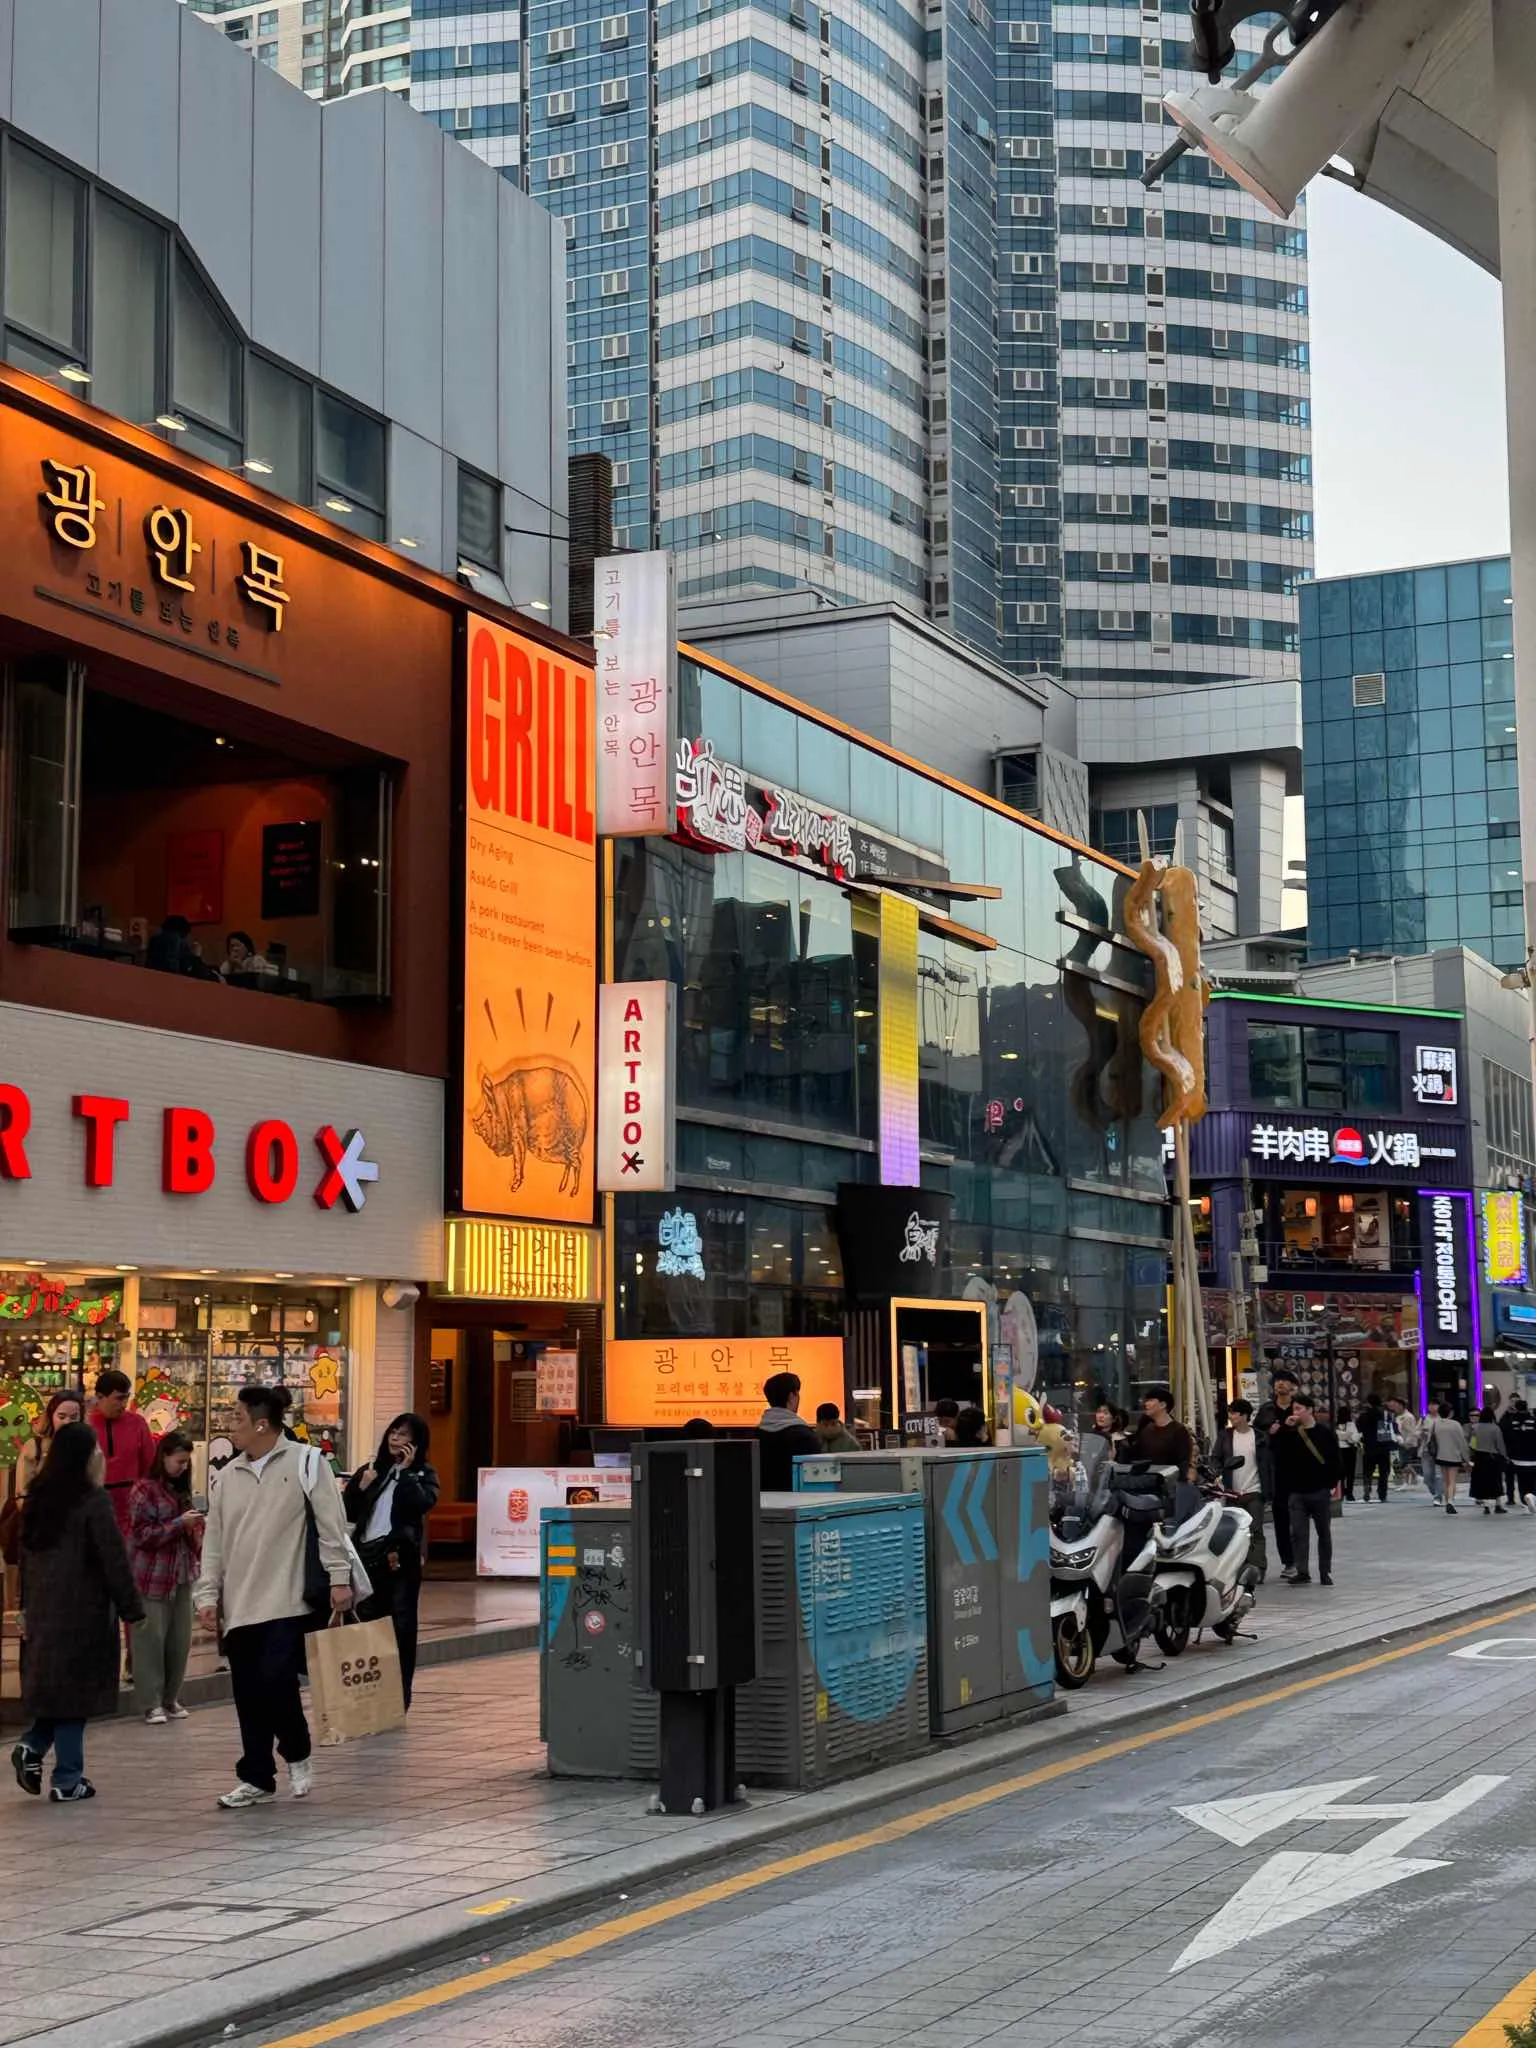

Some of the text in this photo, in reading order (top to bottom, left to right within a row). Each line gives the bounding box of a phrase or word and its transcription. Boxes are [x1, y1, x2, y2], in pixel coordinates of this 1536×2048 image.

[40, 458, 290, 632] 광안목
[603, 569, 621, 758] 고기를 보는 안목
[470, 627, 594, 846] GRILL
[629, 677, 662, 822] 광안목
[470, 836, 514, 866] Dry Aging
[470, 869, 518, 897] Asado Grill
[469, 899, 545, 934] A pork restaurant
[497, 932, 521, 948] never
[522, 935, 542, 953] been
[620, 998, 645, 1175] ARTBOX
[1411, 1073, 1444, 1095] 火鍋
[1250, 1123, 1421, 1168] 羊肉串 火鍋
[653, 1346, 793, 1374] 광안목
[655, 1381, 710, 1397] 프리미엄
[718, 1380, 743, 1396] 목살
[905, 1419, 924, 1433] CCTV
